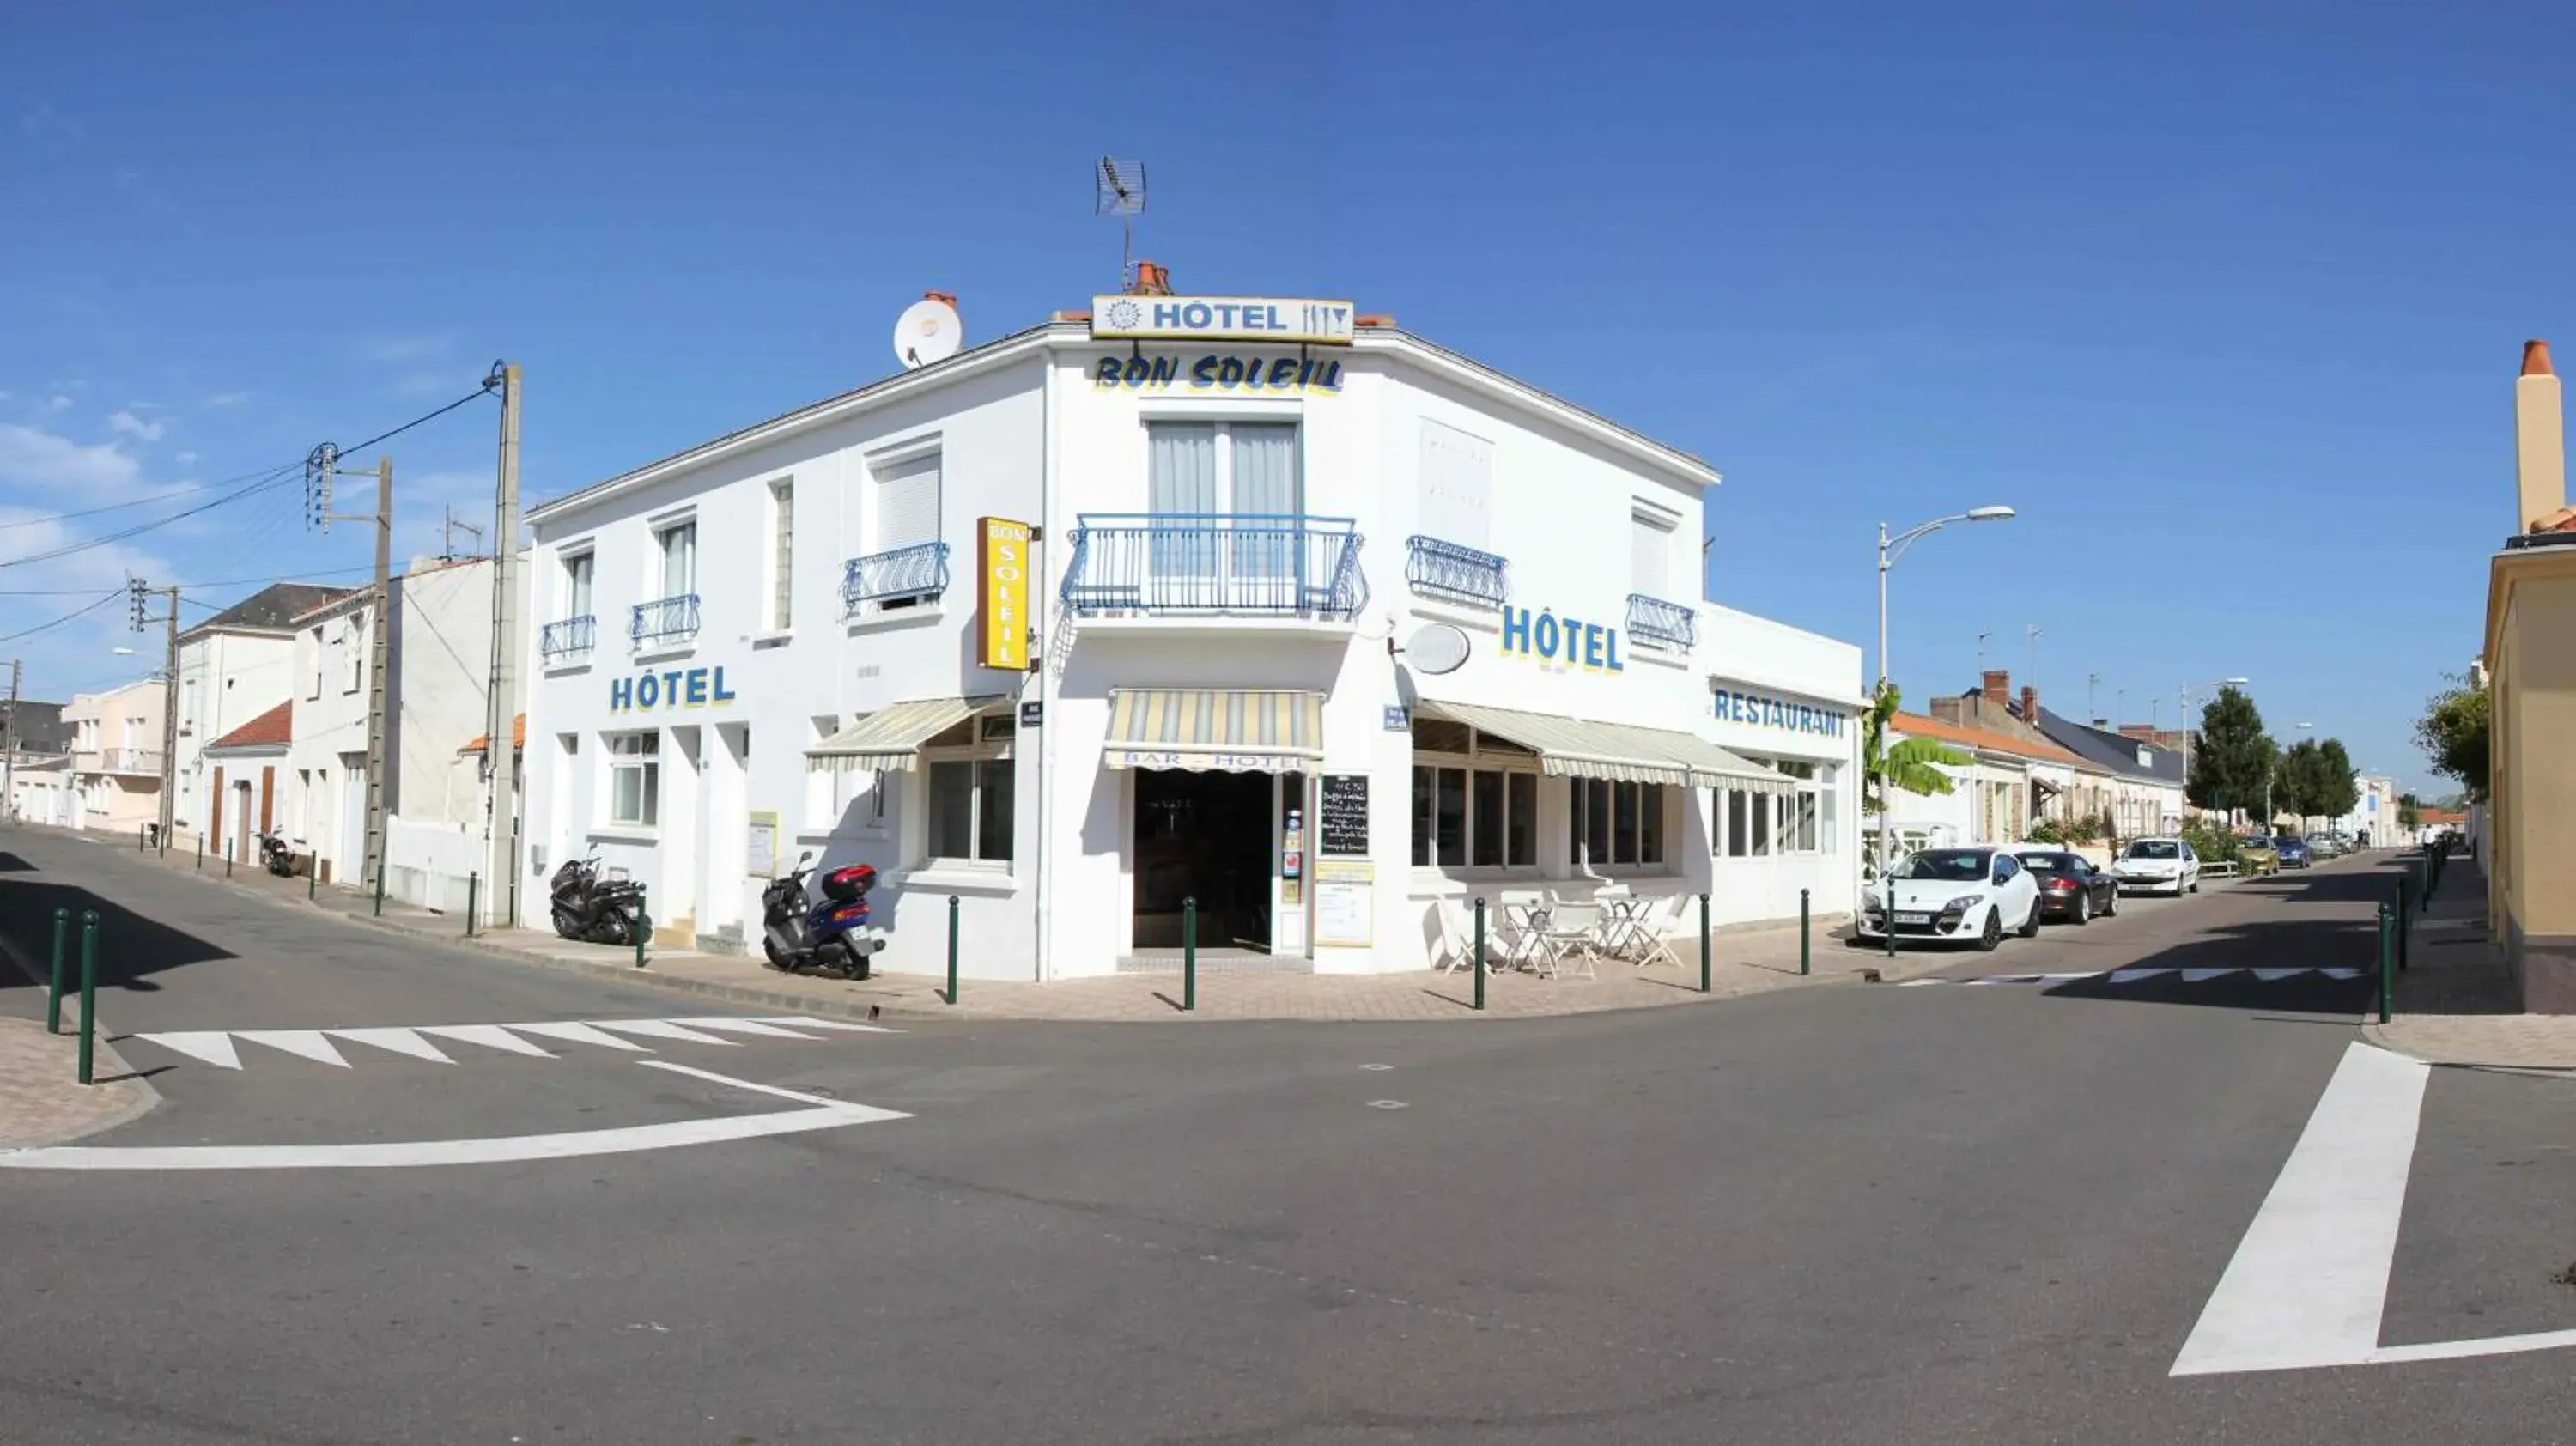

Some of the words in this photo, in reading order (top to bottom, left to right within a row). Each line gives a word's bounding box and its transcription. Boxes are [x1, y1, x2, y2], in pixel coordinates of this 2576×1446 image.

[1153, 301, 1287, 330] HÔTEL
[1095, 355, 1179, 389] BON
[1192, 355, 1343, 392] SOLEIL
[989, 524, 1026, 543] BON
[995, 545, 1019, 663] SOLEIL
[1503, 605, 1624, 672] HÔTEL
[611, 665, 736, 713] HÔTEL
[1714, 689, 1846, 738] RESTAURANT
[1123, 751, 1181, 764] BAR
[1213, 754, 1305, 769] HOTEL
